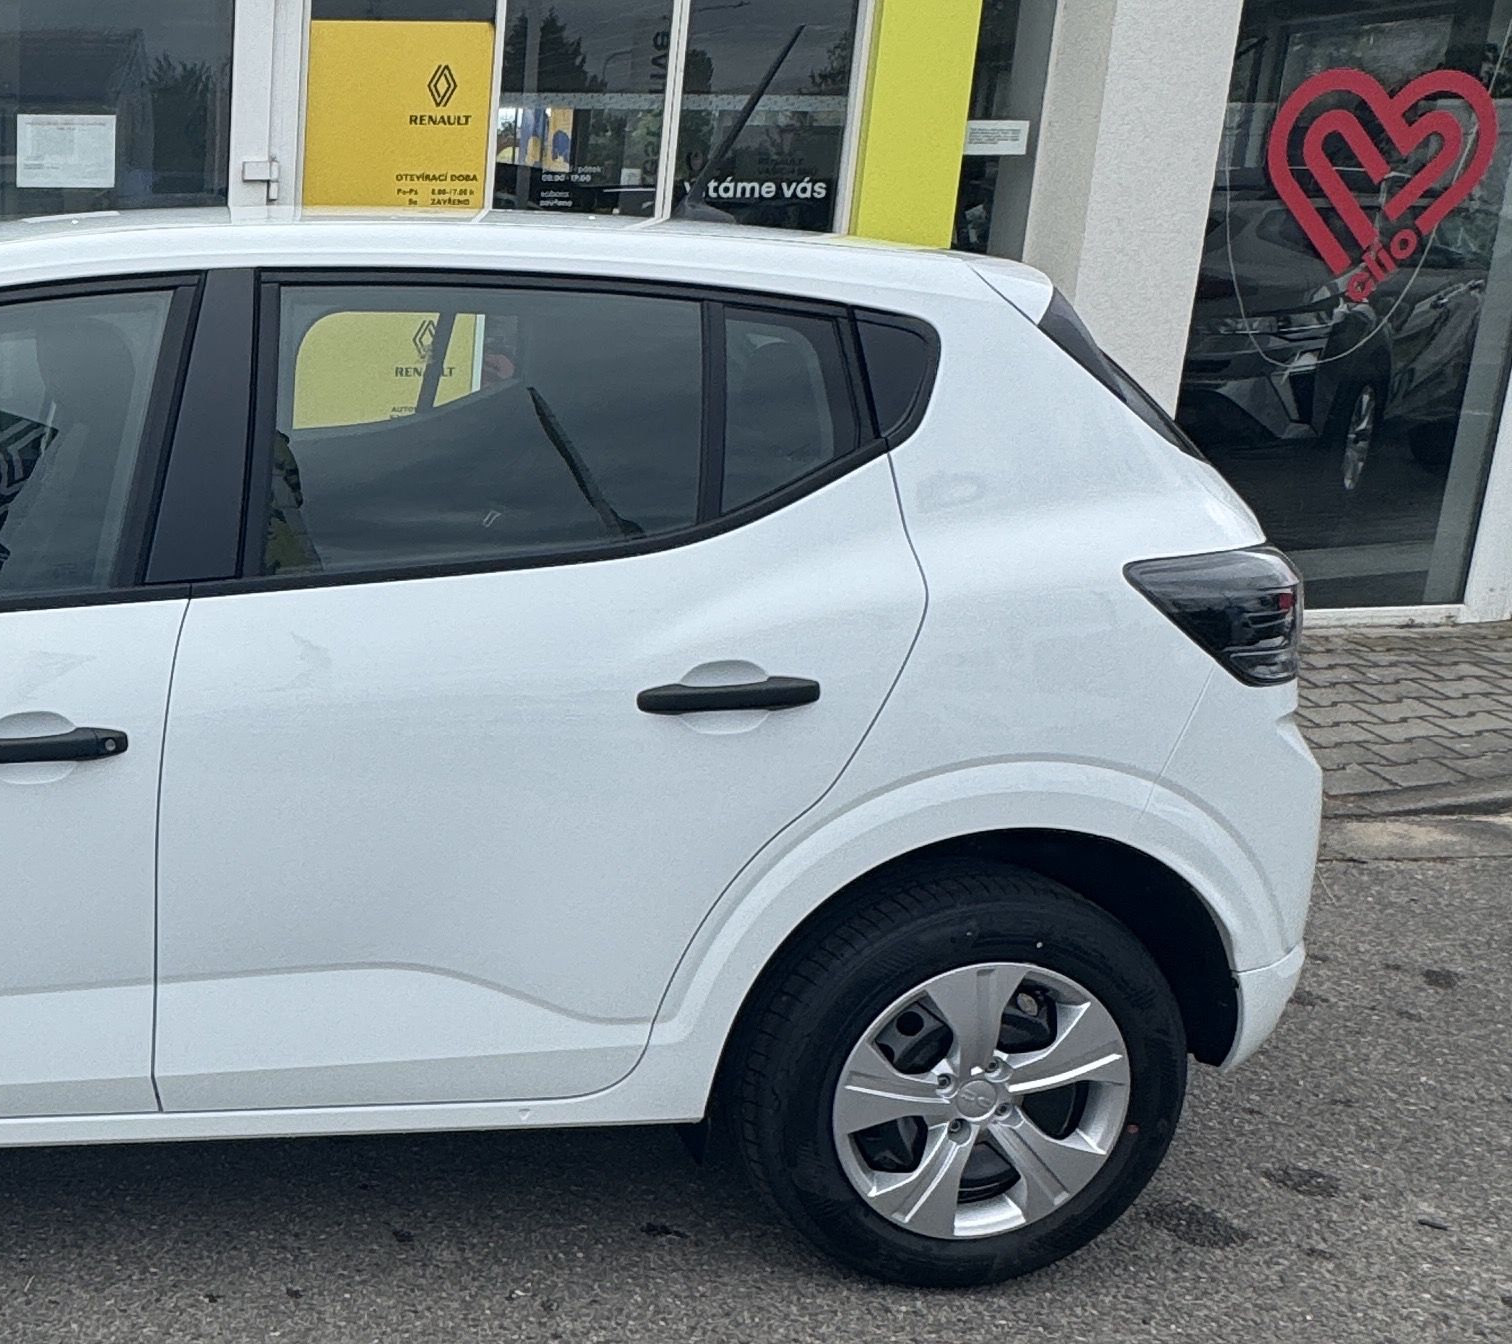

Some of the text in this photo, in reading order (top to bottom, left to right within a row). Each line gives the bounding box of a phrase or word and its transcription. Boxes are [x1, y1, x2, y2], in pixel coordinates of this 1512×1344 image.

[409, 115, 472, 126] RENAULT
[395, 172, 478, 182] OTEVÍRACÍ DOBA
[683, 176, 827, 199] vtáme vás
[1346, 228, 1418, 302] clio
